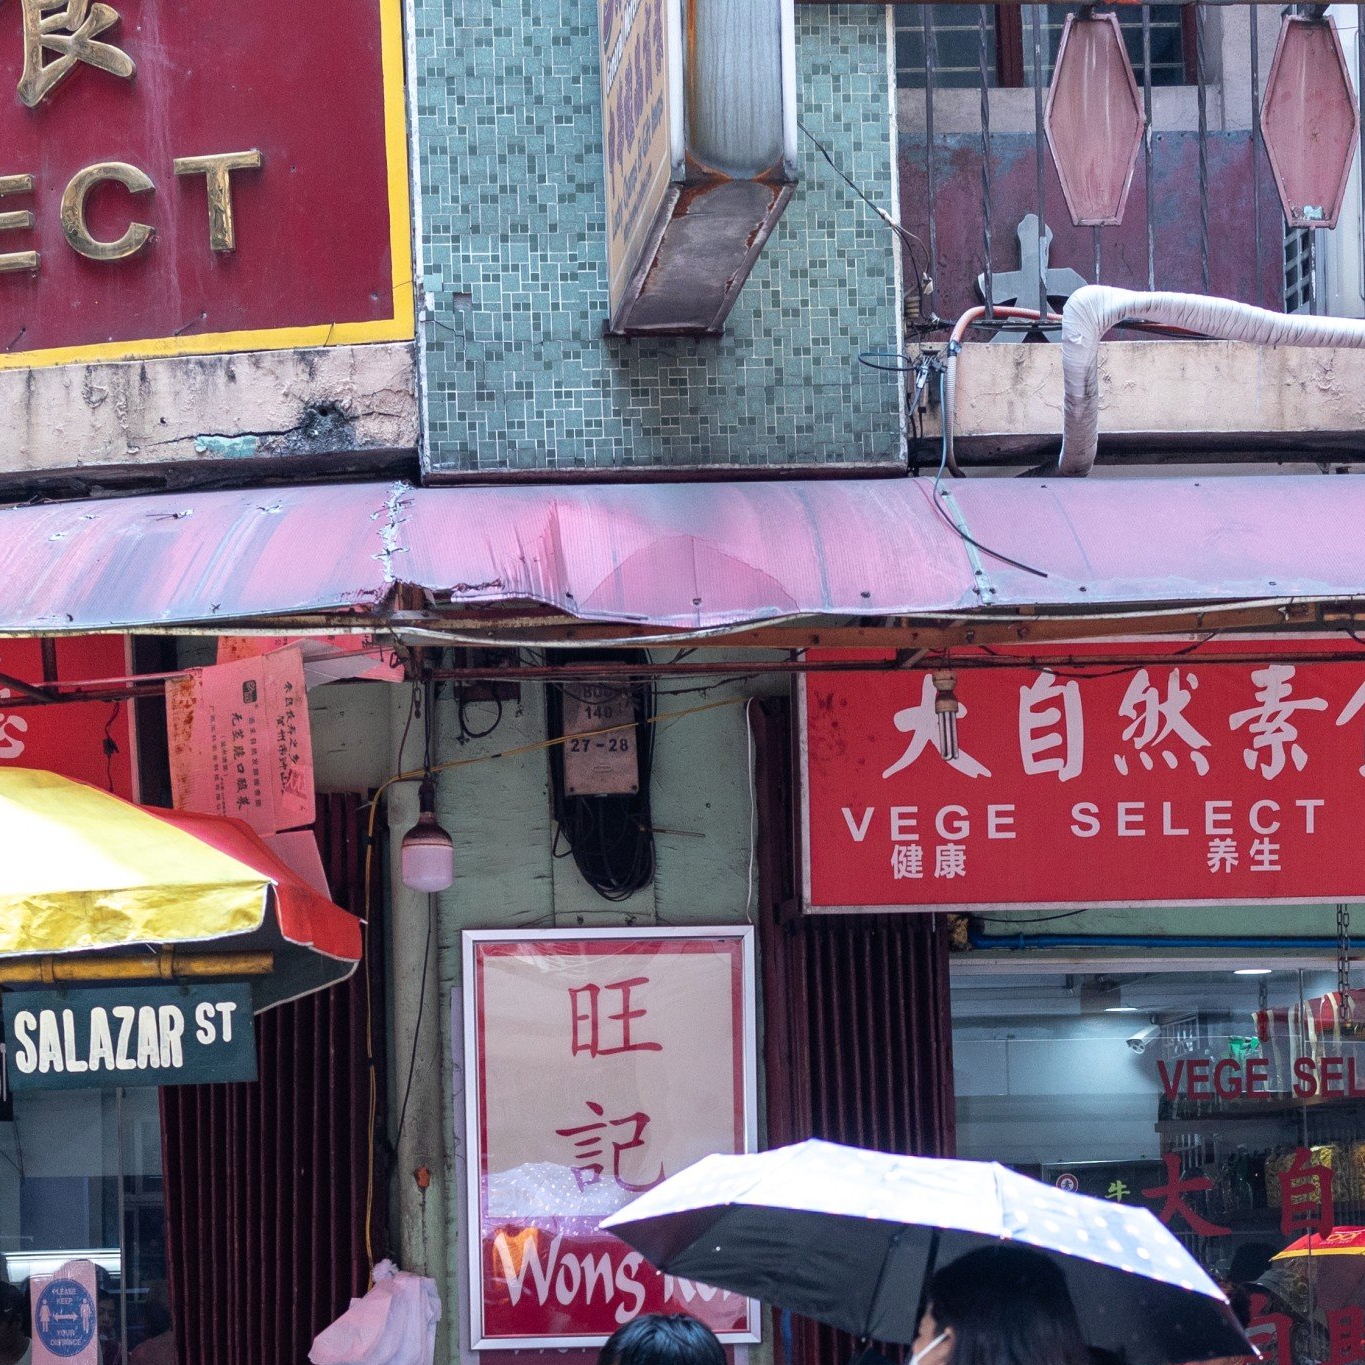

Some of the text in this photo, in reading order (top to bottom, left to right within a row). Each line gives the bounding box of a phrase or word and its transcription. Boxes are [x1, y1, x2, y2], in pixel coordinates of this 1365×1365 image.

[842, 804, 1017, 842] VEGE
[1071, 799, 1325, 838] SELECT
[890, 843, 967, 880] 健康
[1207, 838, 1282, 874] 养生
[14, 1002, 238, 1074] SALAZAR ST
[555, 976, 664, 1193] 旺記
[1157, 1058, 1269, 1101] VEGE
[494, 1231, 646, 1324] Wong
